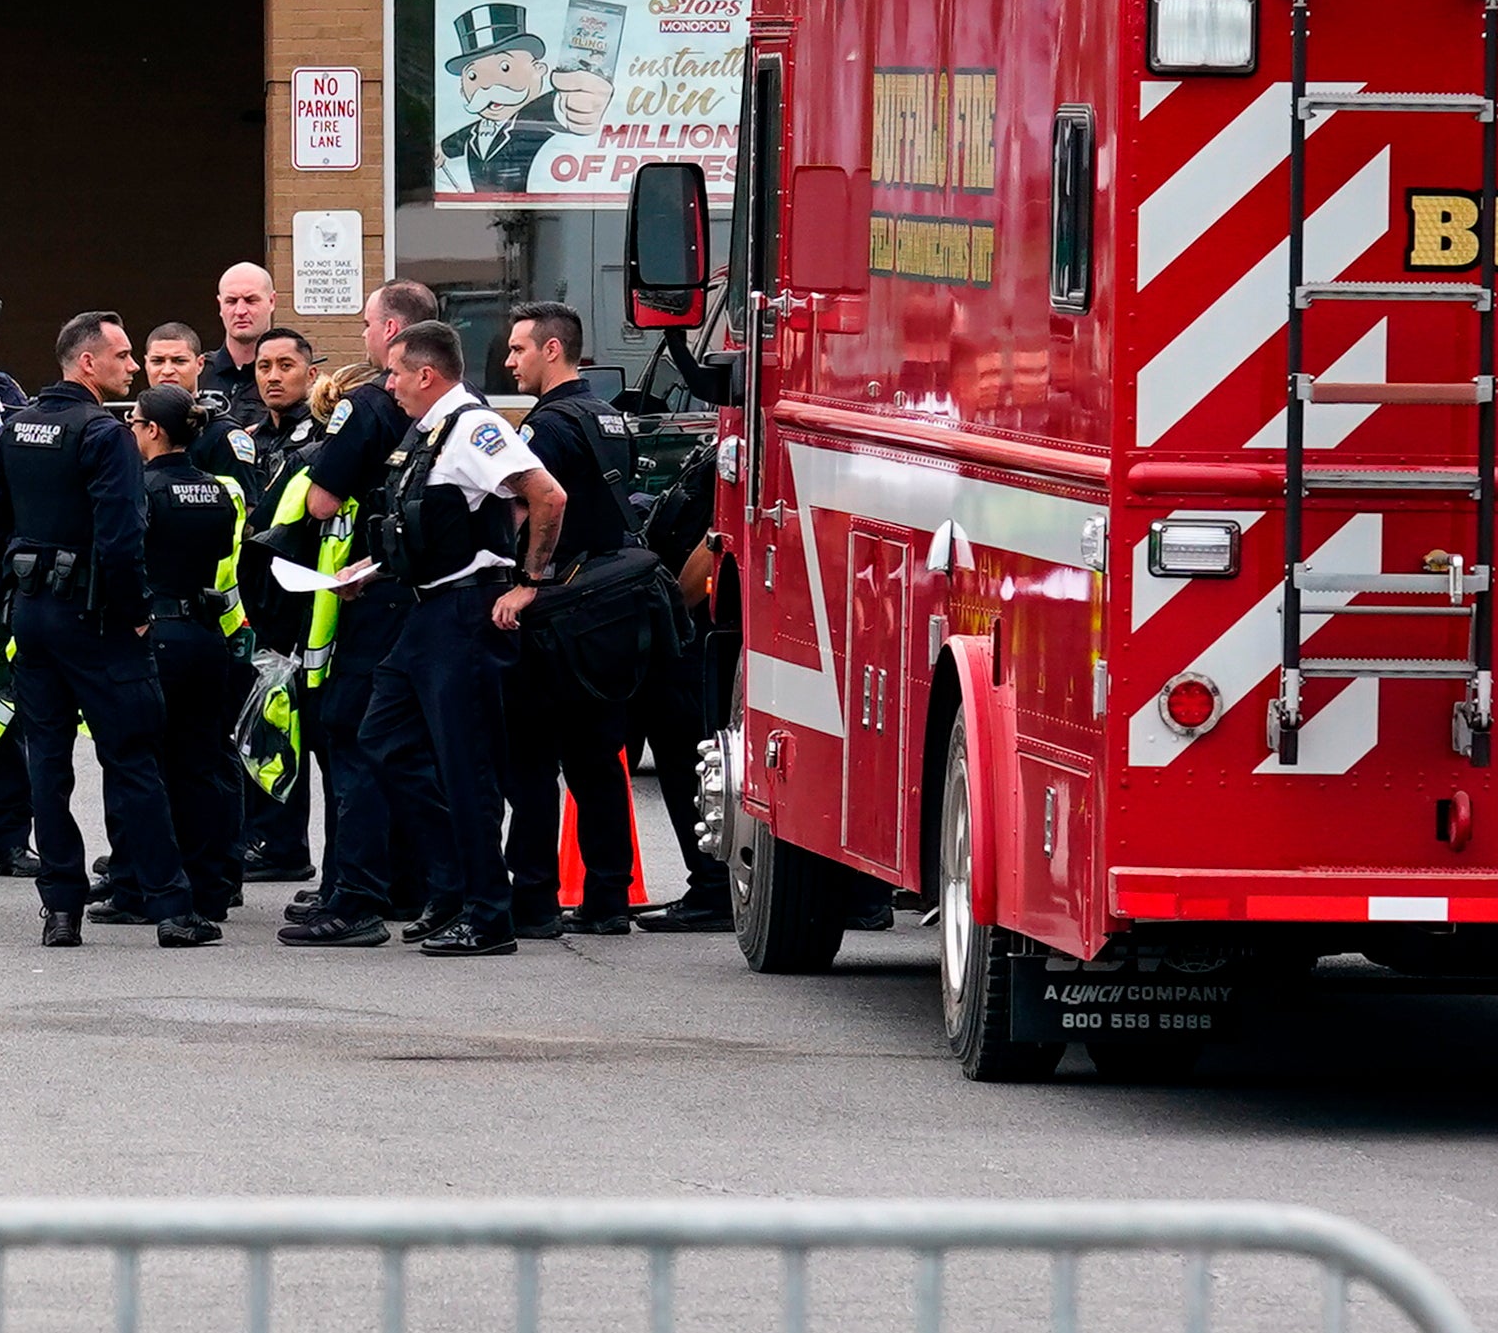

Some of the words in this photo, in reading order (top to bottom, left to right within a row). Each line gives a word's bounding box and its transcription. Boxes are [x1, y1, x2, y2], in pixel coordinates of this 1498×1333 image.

[661, 21, 729, 32] MONOPOLY
[628, 47, 744, 93] instantl
[314, 77, 338, 96] NO
[298, 100, 355, 118] PARKING
[312, 120, 339, 133] FIRE
[871, 70, 949, 190] BUFFALO
[952, 71, 997, 190] FIRE
[310, 135, 342, 148] LANE
[550, 154, 610, 182] OF
[317, 260, 331, 268] NOT
[14, 422, 61, 436] BUFFALO
[15, 432, 54, 445] POLICE
[172, 484, 220, 494] BUFFALO
[179, 493, 218, 503] POLICE
[1044, 984, 1059, 1000] A
[1060, 985, 1125, 1005] LYNCH
[1127, 986, 1232, 1002] COMPANY
[1062, 1013, 1102, 1029] 800
[1110, 1013, 1150, 1029] 558
